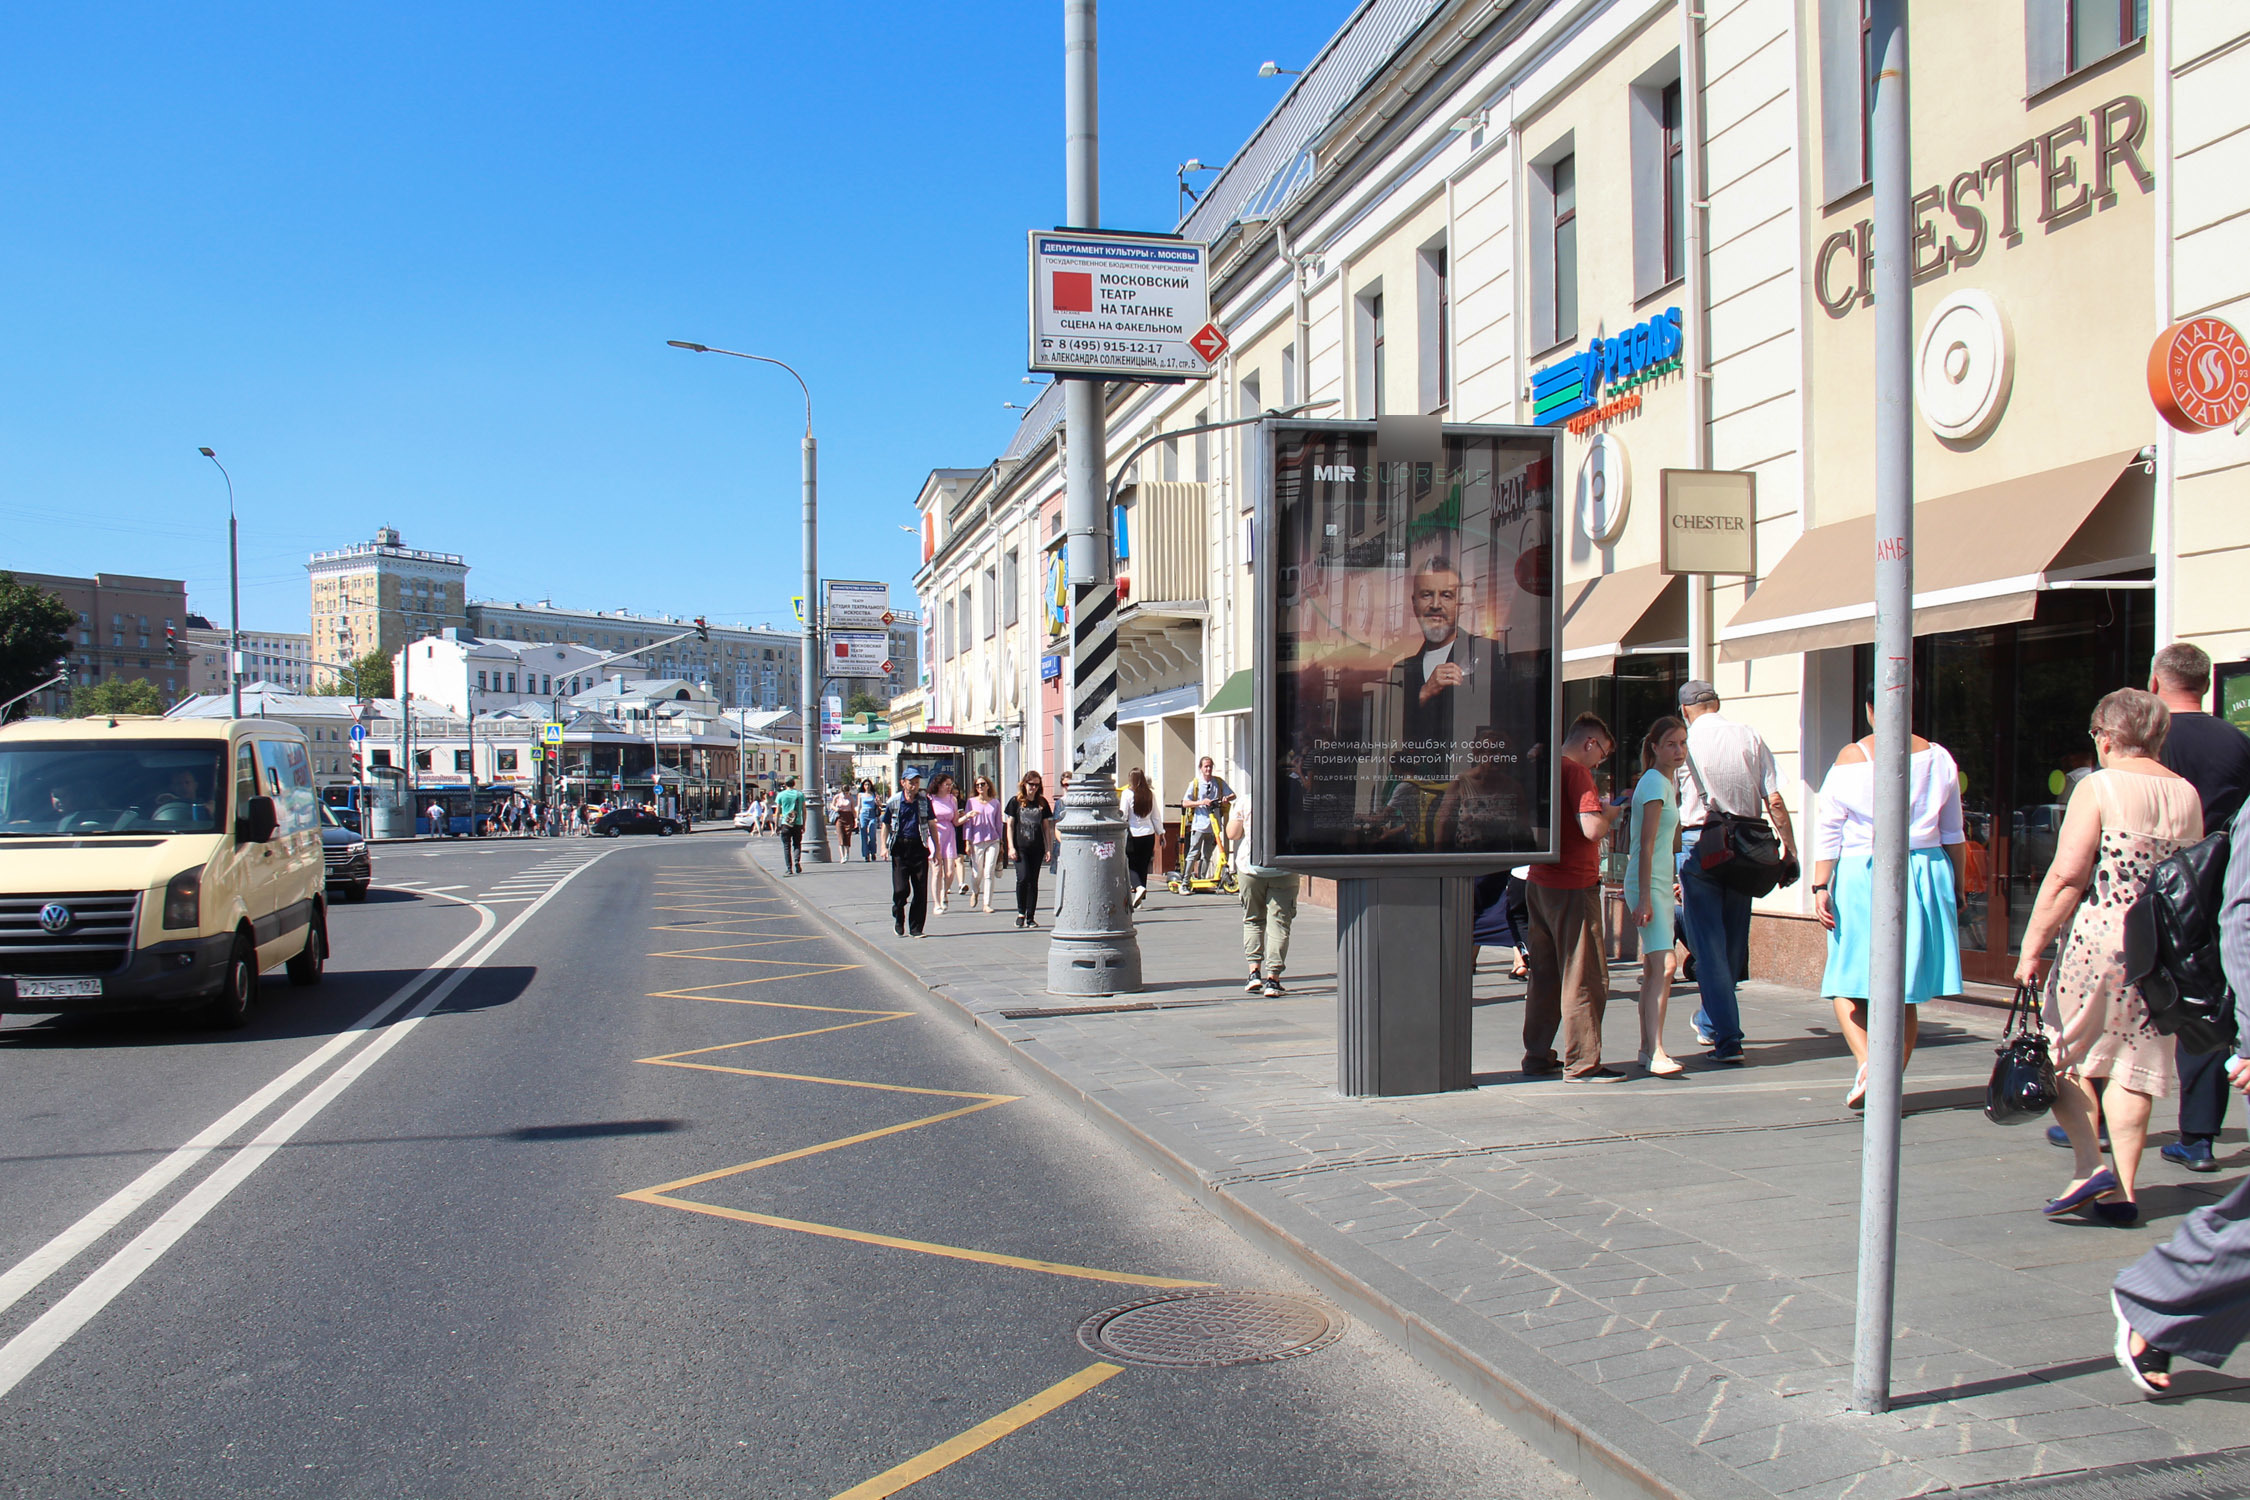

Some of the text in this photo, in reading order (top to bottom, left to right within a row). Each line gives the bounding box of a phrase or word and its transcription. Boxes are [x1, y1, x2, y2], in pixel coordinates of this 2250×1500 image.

[1044, 243, 1103, 255] ДЕПАРТАМЕНТ
[1105, 247, 1149, 258] КУЛЬТУРЫ
[1158, 252, 1195, 260] МОСКВЫ
[1045, 257, 1195, 273] ГОСУДАРСТВЕННОЕ БЮДЖЕТНОЕ УЧРЕЖДЕНИЕ
[1100, 273, 1189, 289] МОСКОВСКИЙ
[1100, 288, 1136, 300] ТЕАТР
[1100, 303, 1174, 318] НА ТАГАНКЕ
[1060, 319, 1183, 334] СЦЕНА НА ФАКЕЛЬНОМ
[1058, 339, 1163, 354] 8 (495) 915-12-17
[1604, 307, 1682, 384] PEGAS
[1041, 354, 1050, 363] ул.
[1051, 353, 1099, 365] АЛЕКСАНДРА
[1100, 355, 1159, 368] СОЛЖЕНИЦЫНА,
[1191, 359, 1196, 369] 5
[2238, 369, 2249, 378] 93
[1313, 464, 1488, 486] MIR SUPREME
[1672, 514, 1744, 531] CHESTER
[1314, 739, 1505, 750] Премиальный кешбэк и особые
[1313, 753, 1518, 765] привилегии с картой Mir Supreme
